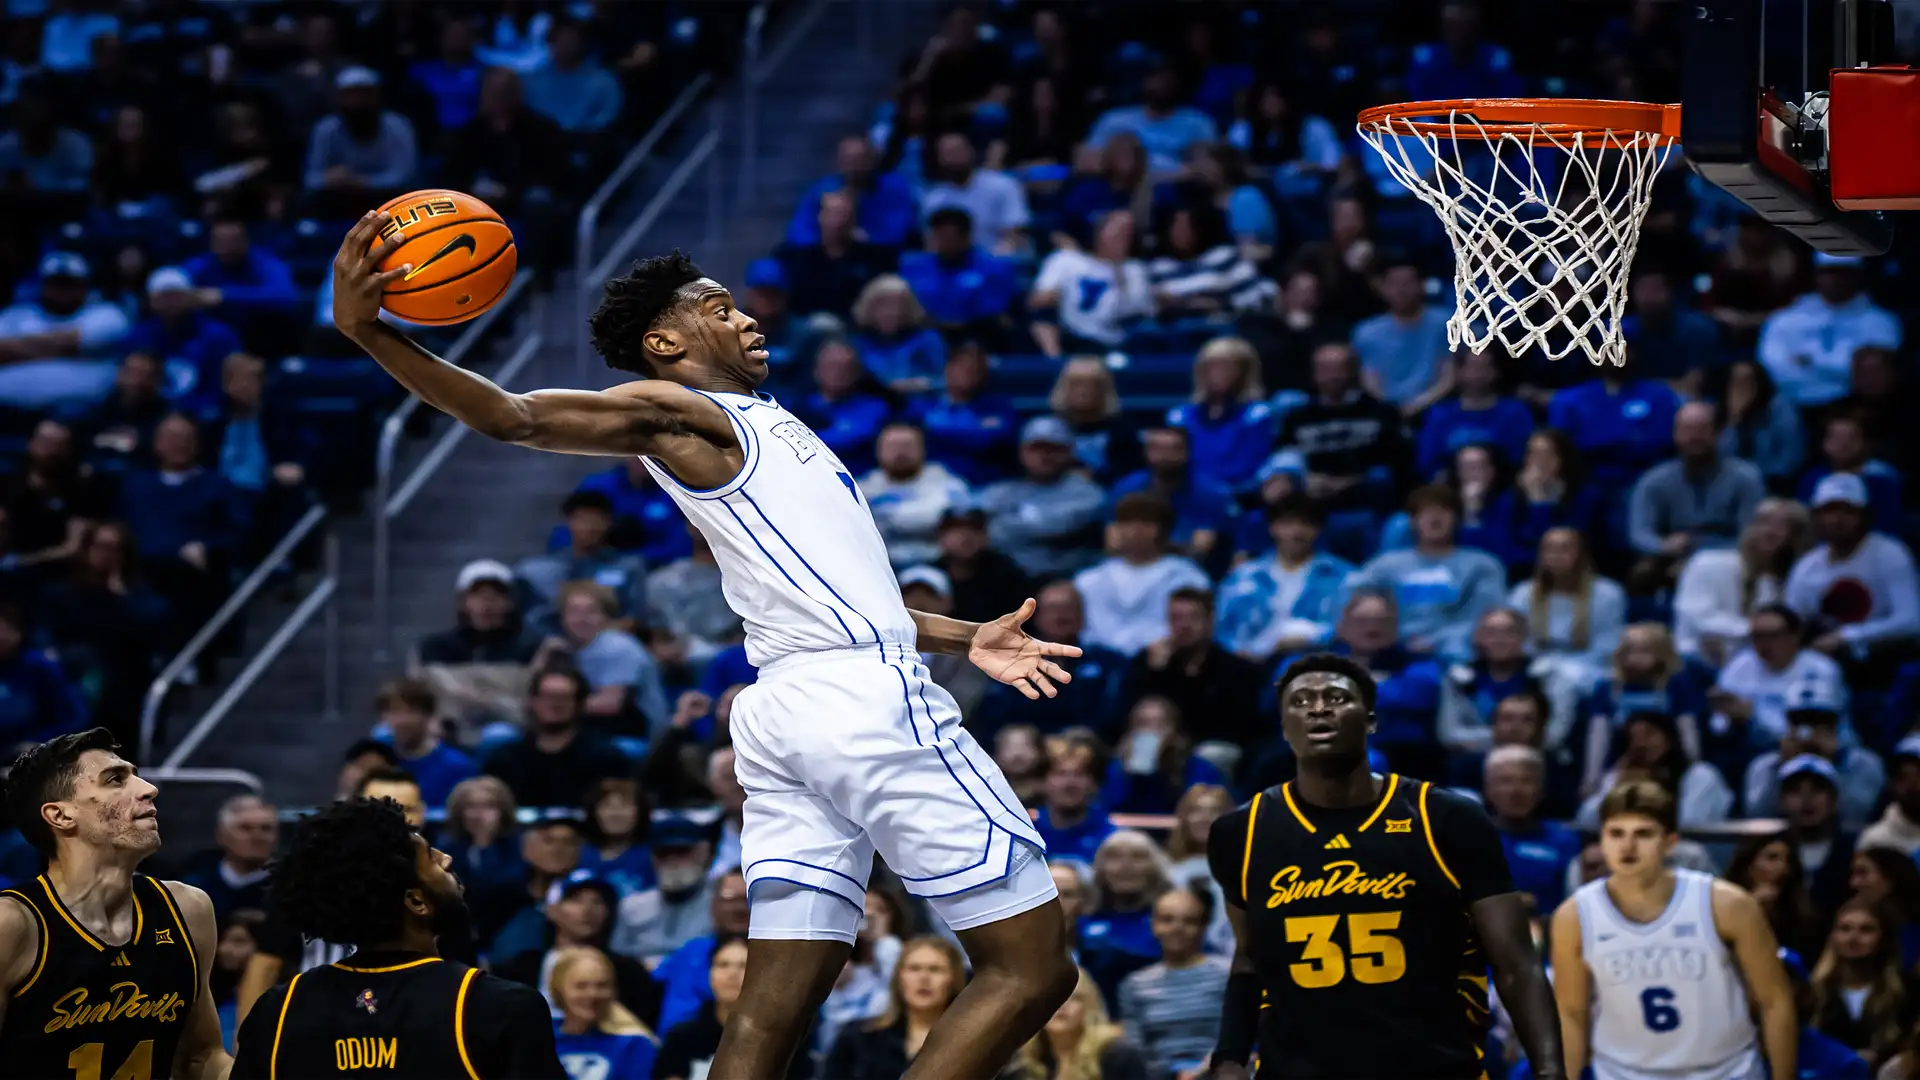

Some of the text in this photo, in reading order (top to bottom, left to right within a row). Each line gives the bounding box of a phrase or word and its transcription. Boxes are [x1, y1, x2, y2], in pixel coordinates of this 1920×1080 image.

[379, 199, 459, 240] ELITE
[1284, 911, 1406, 989] 35
[1604, 945, 1707, 986] BYU
[1640, 986, 1682, 1033] 6
[335, 1037, 398, 1071] ODUM
